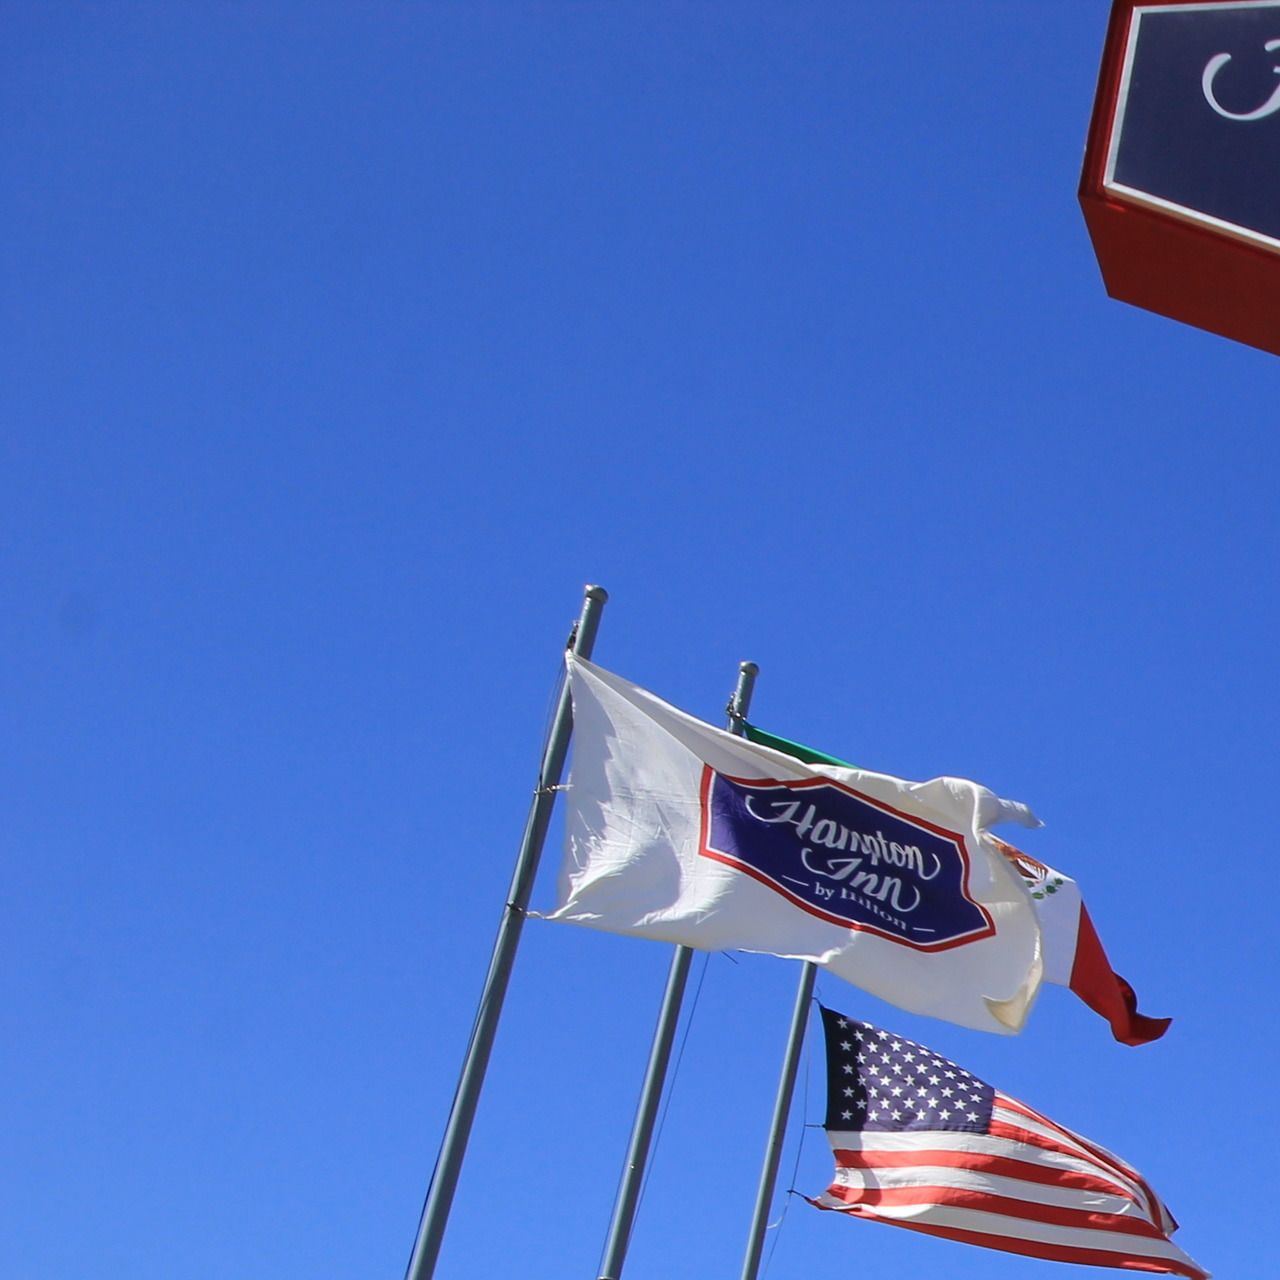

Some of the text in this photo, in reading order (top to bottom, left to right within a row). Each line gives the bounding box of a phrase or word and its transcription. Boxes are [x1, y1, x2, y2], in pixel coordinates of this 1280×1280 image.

[745, 794, 941, 880] Hampton
[801, 847, 920, 913] Inn
[814, 881, 835, 900] by
